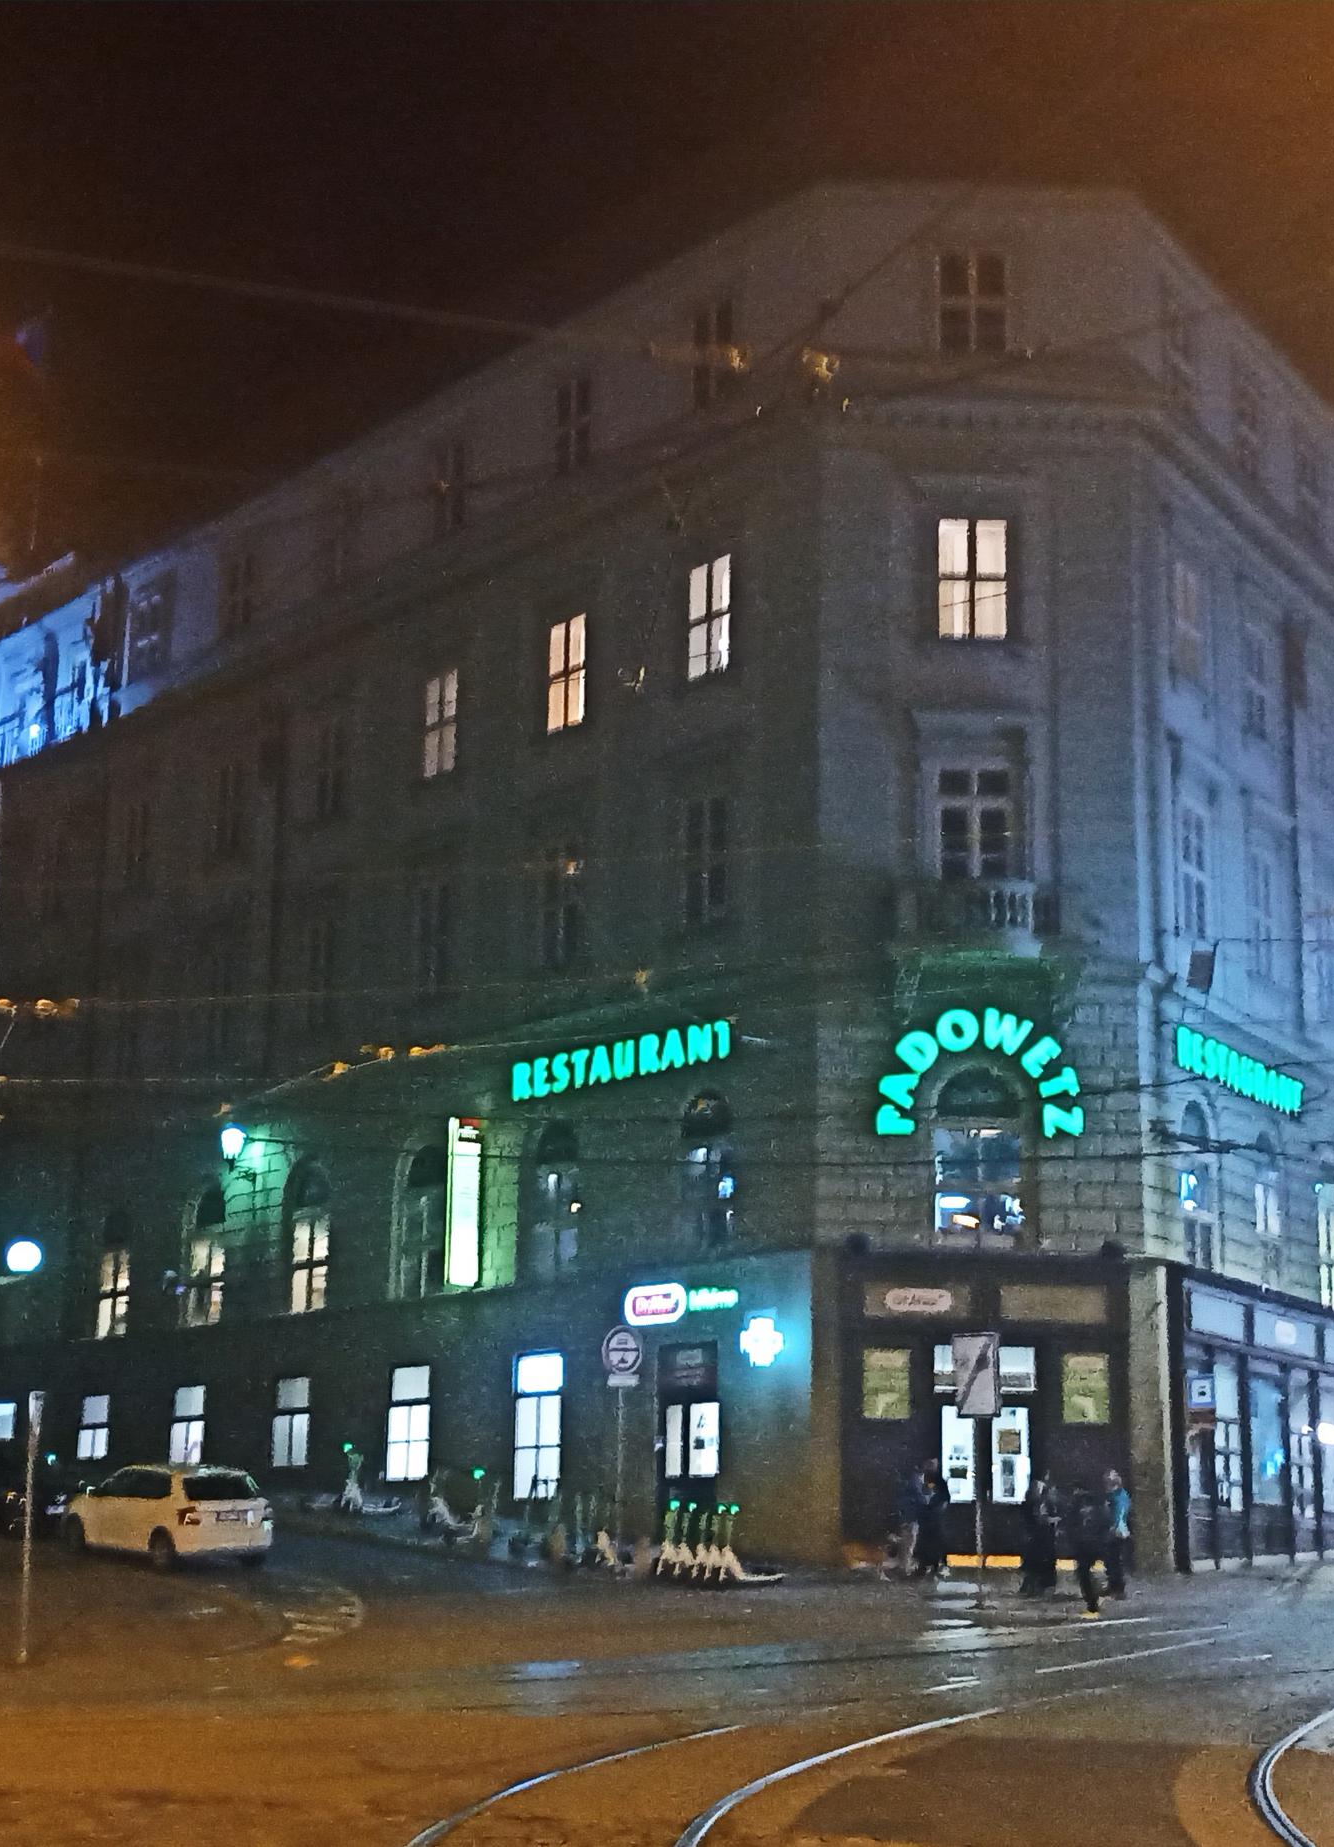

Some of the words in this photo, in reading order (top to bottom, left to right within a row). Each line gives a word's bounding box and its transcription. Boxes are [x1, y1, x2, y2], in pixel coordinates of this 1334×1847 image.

[512, 1019, 731, 1102] RESTAURANT
[875, 1007, 1084, 1139] PADOWETZ
[1176, 1025, 1305, 1117] RESTAURANT
